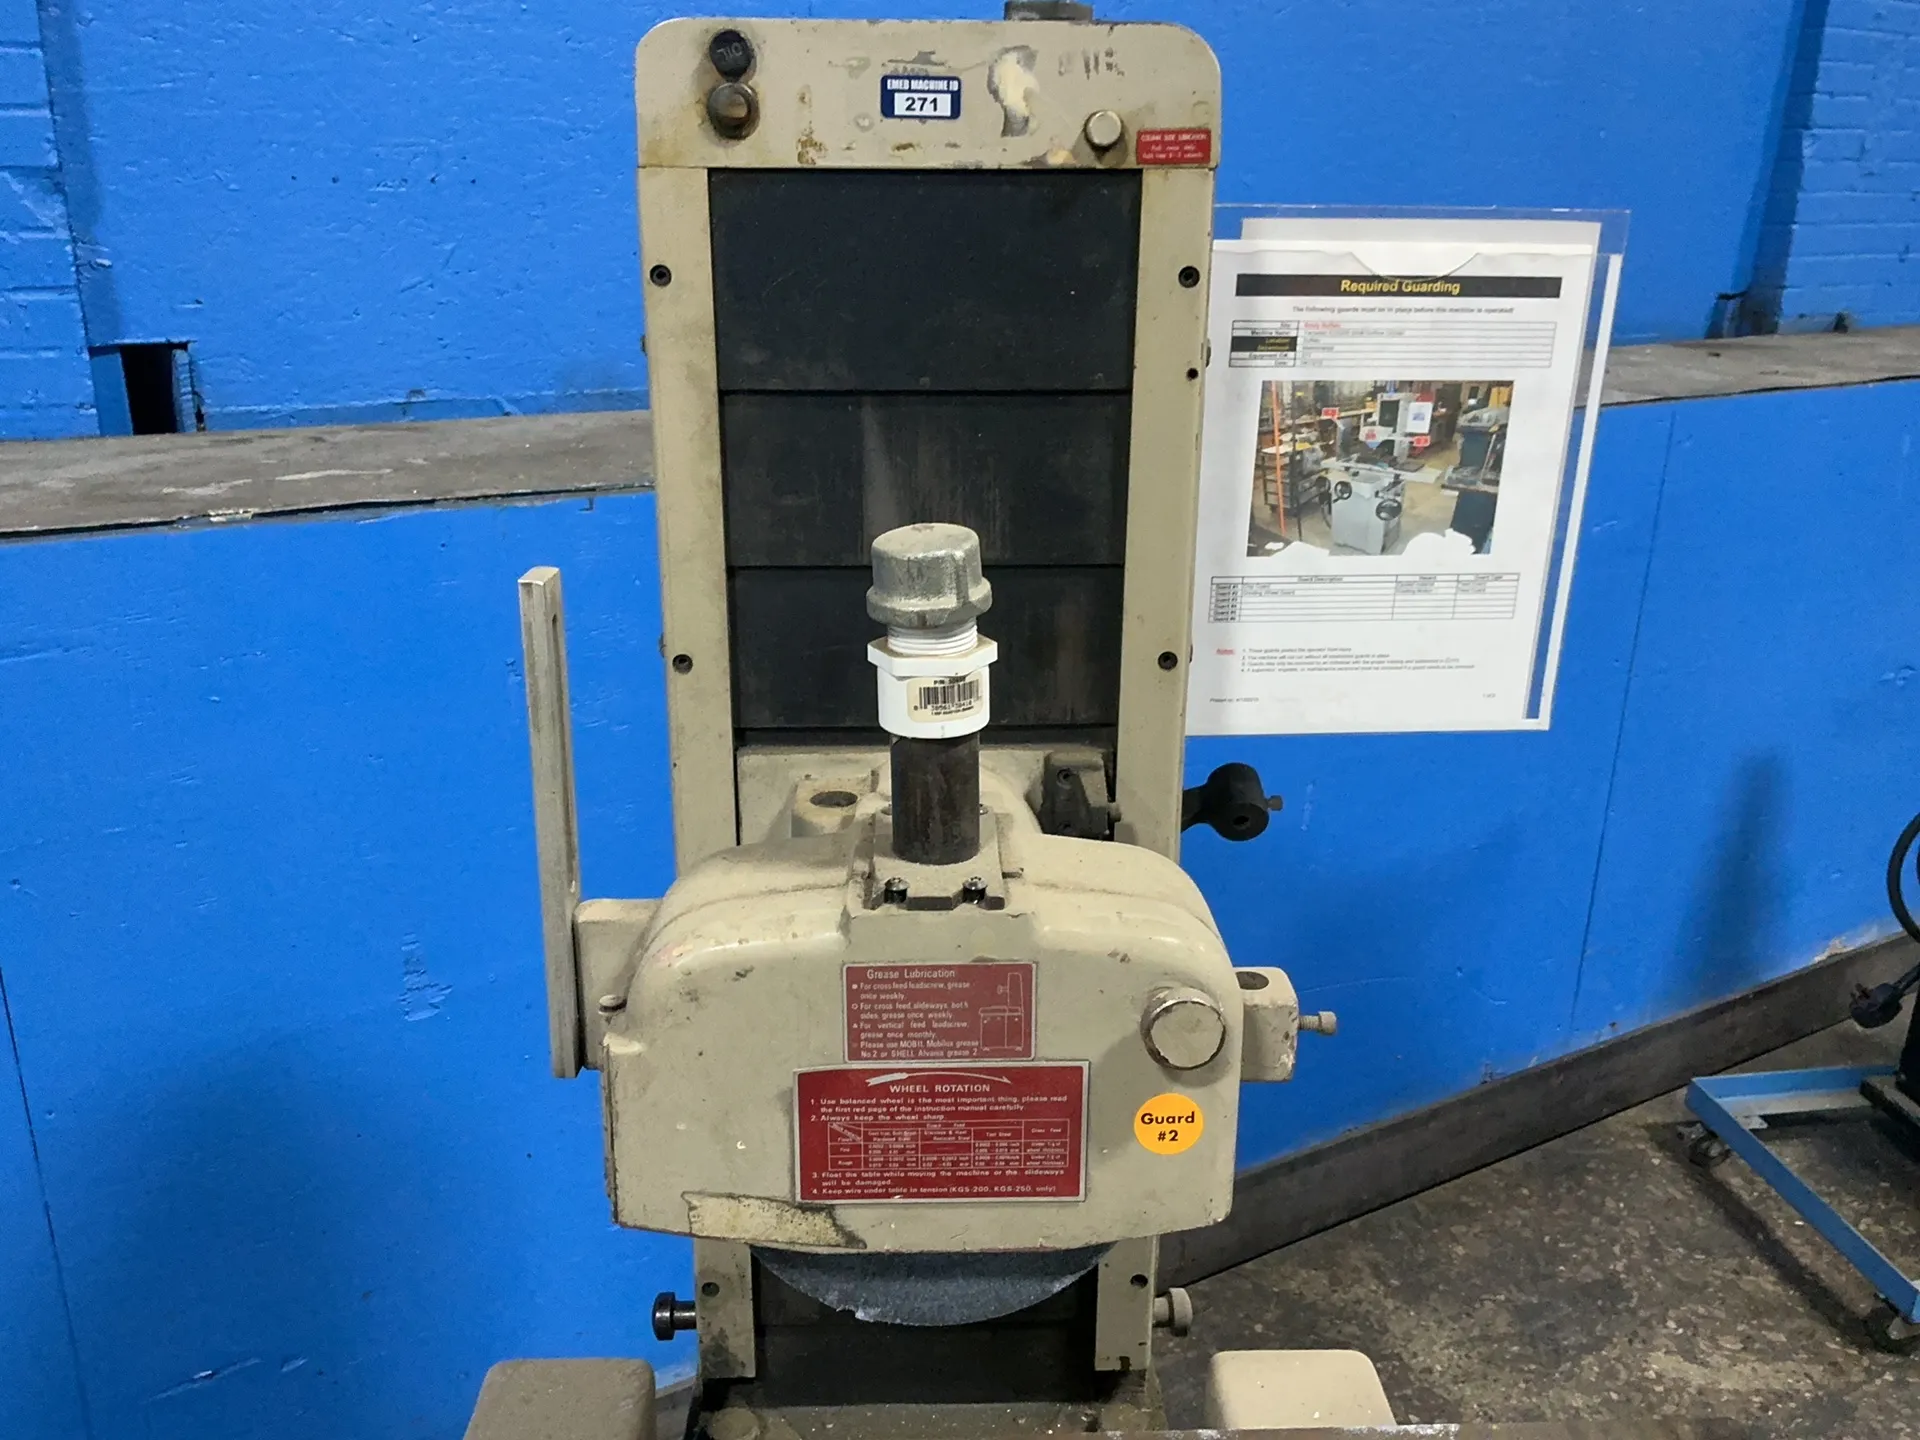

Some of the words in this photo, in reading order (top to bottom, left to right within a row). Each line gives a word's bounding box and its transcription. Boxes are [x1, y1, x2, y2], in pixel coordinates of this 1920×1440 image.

[911, 78, 948, 91] MACHINE
[949, 79, 959, 91] ID
[904, 96, 938, 113] 271
[1340, 279, 1398, 295] Required
[1401, 280, 1461, 295] Guarding
[866, 968, 900, 980] Grease
[904, 967, 956, 979] Lubrication
[860, 982, 872, 991] For
[873, 982, 892, 991] cross
[892, 981, 908, 990] feed
[946, 981, 970, 992] grease
[860, 992, 878, 1000] once
[860, 1002, 872, 1011] For
[874, 1003, 893, 1011] cross
[895, 1001, 911, 1011] feed
[950, 1001, 969, 1010] both
[881, 1011, 906, 1021] grease
[906, 1010, 924, 1018] once
[860, 1020, 872, 1029] For
[877, 1020, 905, 1029] vertical
[909, 1019, 926, 1028] feed
[860, 1031, 884, 1042] grease
[886, 1031, 905, 1039] once
[860, 1041, 884, 1050] Please
[926, 1039, 955, 1048] Mobilux
[955, 1039, 980, 1049] grease
[891, 1048, 915, 1058] SHELL
[946, 1048, 970, 1058] grease
[889, 1084, 929, 1093] WHEEL
[934, 1083, 991, 1093] ROTATION
[820, 1098, 836, 1106] Use
[839, 1097, 877, 1106] balanced
[880, 1097, 905, 1105] wheel
[918, 1097, 934, 1105] the
[935, 1096, 955, 1104] most
[957, 1096, 993, 1106] important
[1021, 1095, 1048, 1104] please
[1050, 1095, 1068, 1103] read
[867, 1106, 888, 1115] page
[889, 1105, 898, 1113] of
[914, 1104, 956, 1113] instruction
[957, 1103, 988, 1112] manual
[820, 1114, 851, 1124] Always
[854, 1113, 874, 1123] keep
[878, 1113, 894, 1121] the
[895, 1113, 919, 1121] wheel
[1140, 1110, 1196, 1126] Guard
[1157, 1129, 1179, 1143] #2
[821, 1171, 842, 1179] Float
[861, 1170, 881, 1179] table
[883, 1170, 905, 1178] while
[907, 1170, 937, 1180] moving
[940, 1169, 952, 1177] the
[955, 1168, 990, 1177] machine
[1005, 1168, 1018, 1176] the
[1024, 1167, 1064, 1177] slideways
[821, 1179, 837, 1187] will
[841, 1178, 852, 1186] be
[821, 1186, 843, 1196] Keep
[844, 1186, 862, 1194] wire
[864, 1185, 886, 1194] under
[887, 1185, 908, 1193] table
[910, 1185, 918, 1193] in
[919, 1184, 948, 1193] tension
[1035, 1184, 1057, 1193] only)
